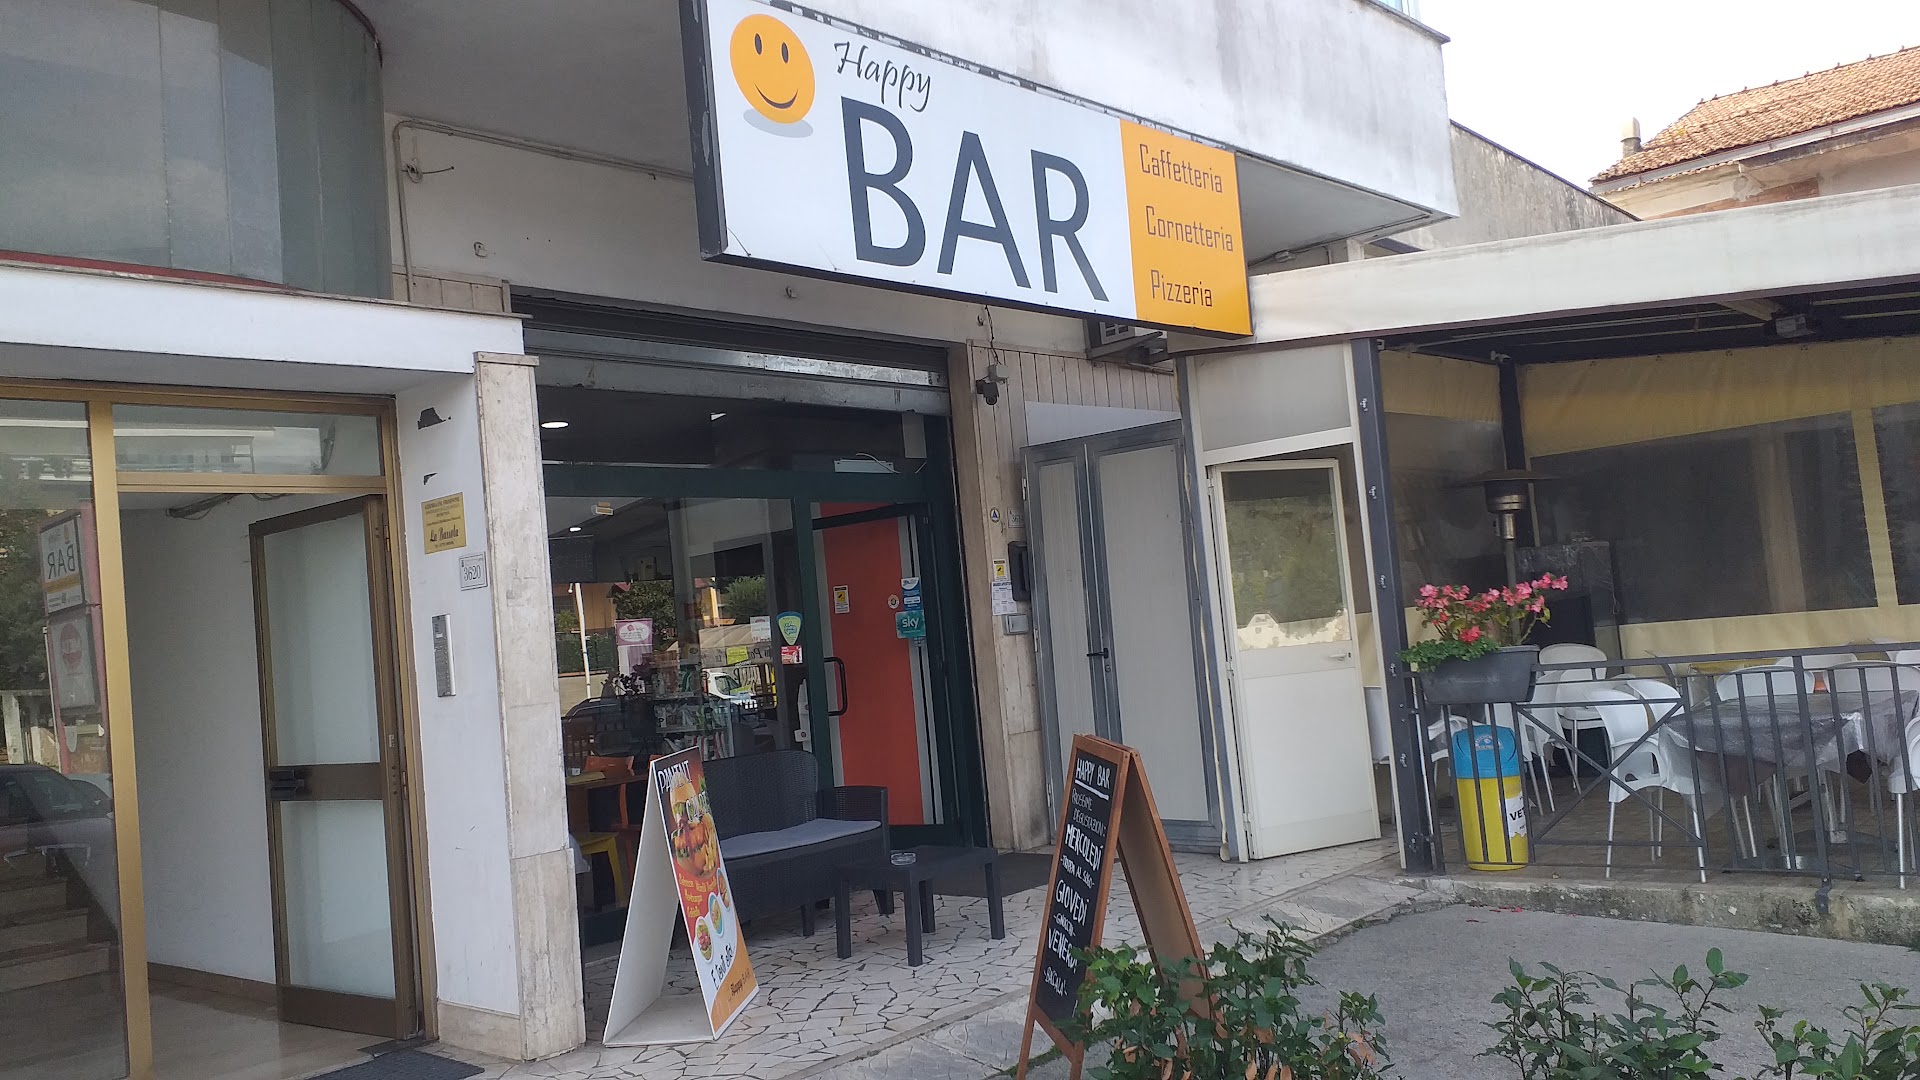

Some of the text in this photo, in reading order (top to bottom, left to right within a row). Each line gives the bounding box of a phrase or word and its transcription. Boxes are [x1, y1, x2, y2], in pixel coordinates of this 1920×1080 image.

[833, 41, 931, 113] Happy
[1139, 143, 1223, 193] Caffetteria
[841, 96, 1110, 303] BAR
[1145, 205, 1233, 252] Cornetteria
[1150, 269, 1213, 307] Pizzeria
[463, 565, 481, 581] 3620
[902, 616, 919, 629] sky
[1075, 758, 1111, 789] HAPPY BAR
